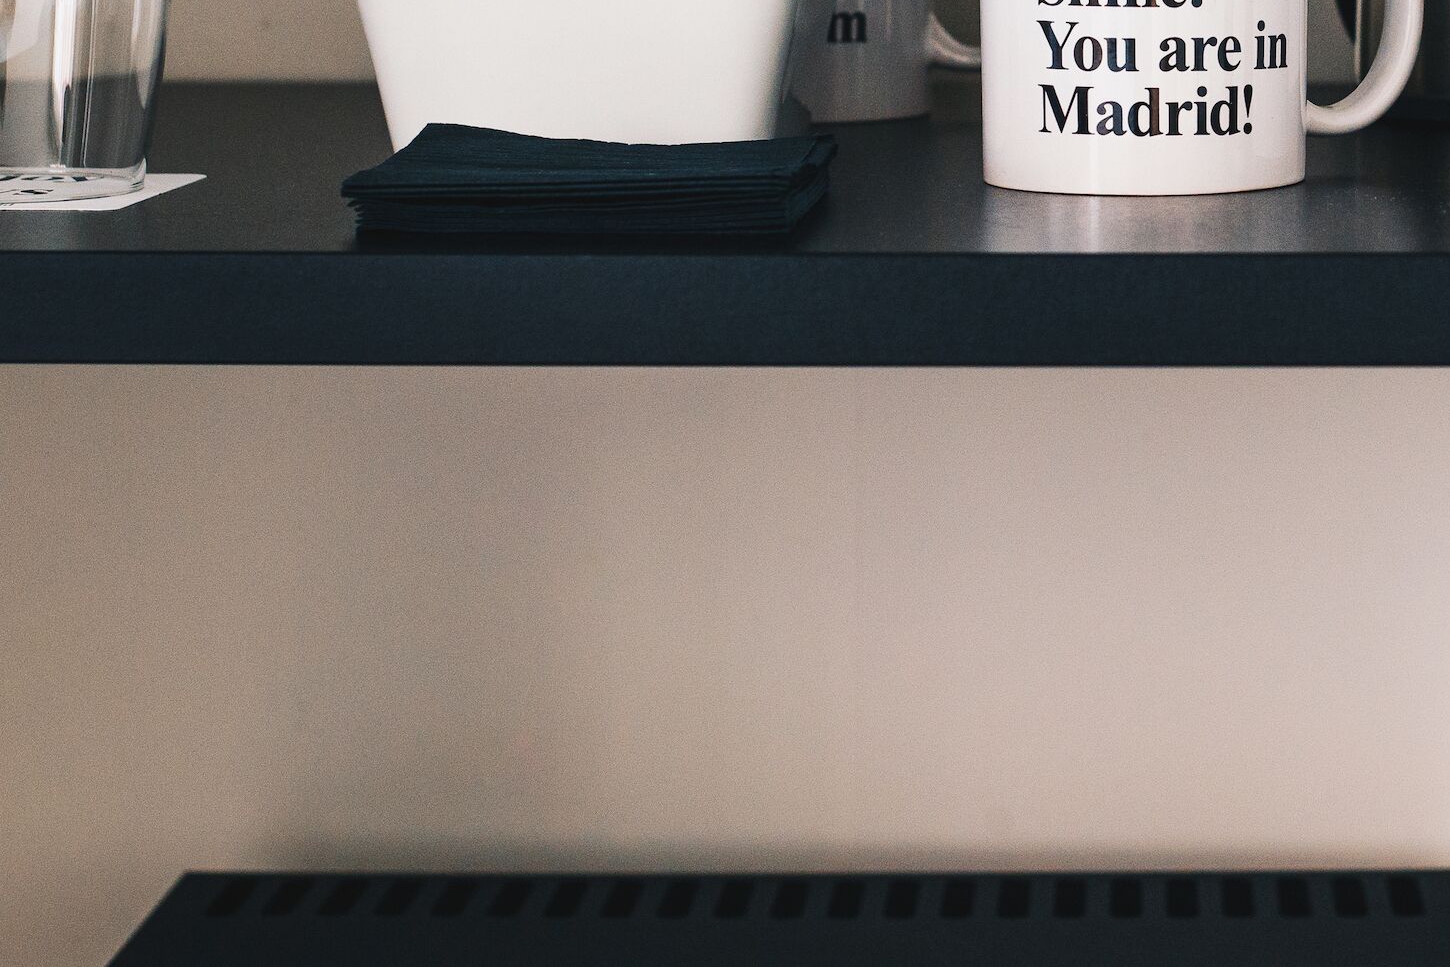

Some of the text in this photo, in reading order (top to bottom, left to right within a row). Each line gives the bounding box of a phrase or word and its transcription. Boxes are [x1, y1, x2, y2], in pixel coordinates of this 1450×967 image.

[1036, 19, 1289, 73] You are in
[1038, 83, 1254, 137] Madrid!
